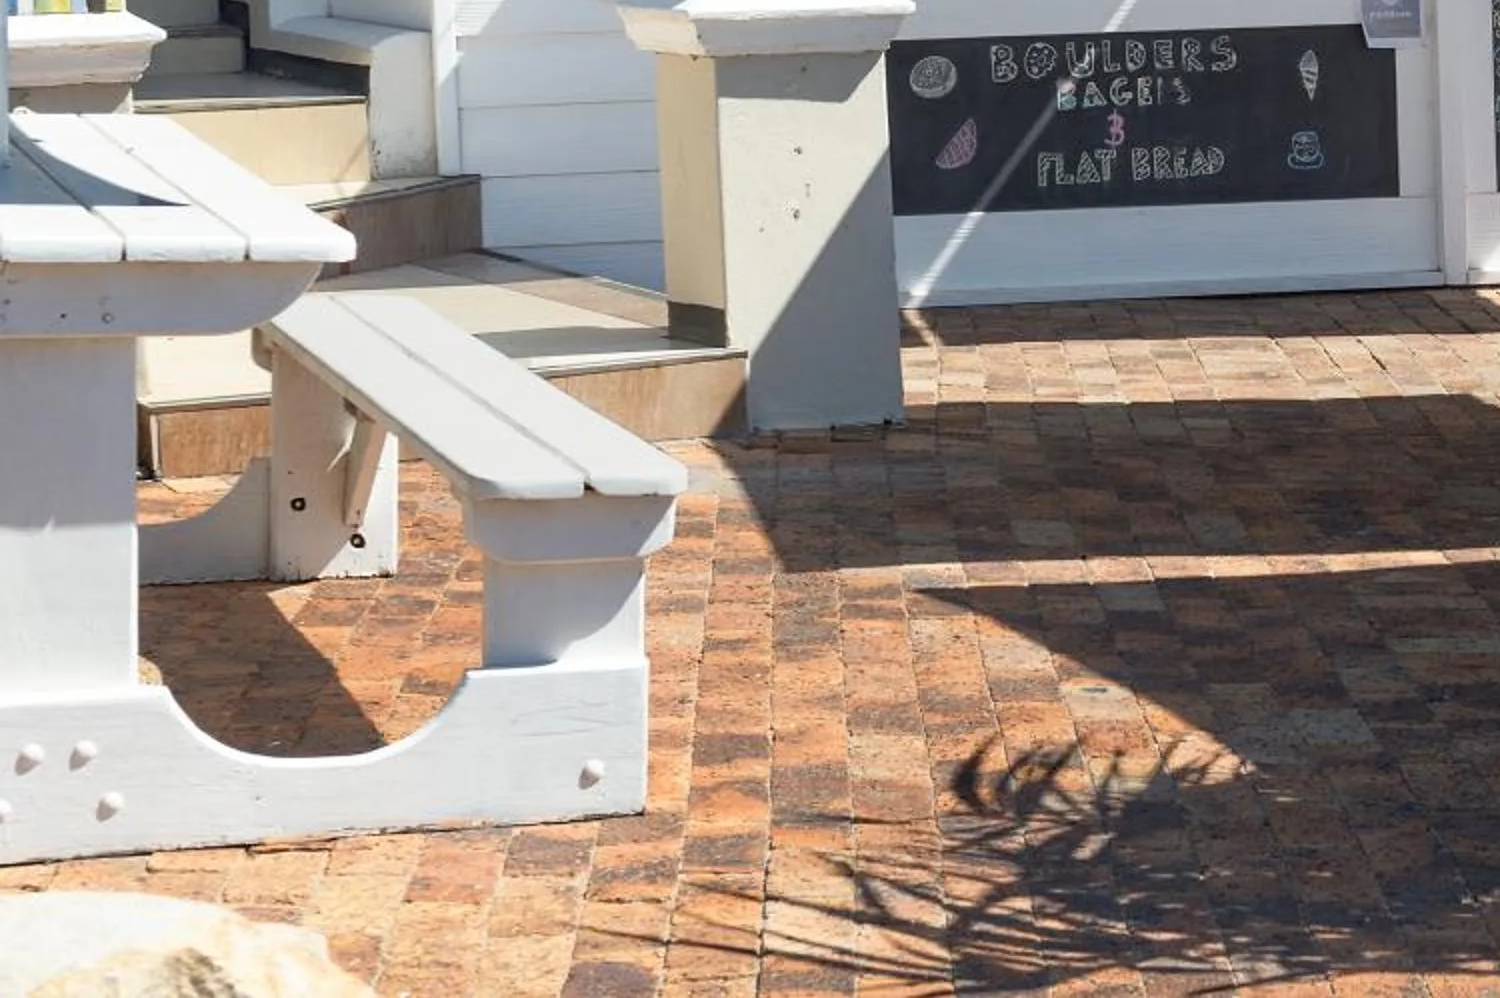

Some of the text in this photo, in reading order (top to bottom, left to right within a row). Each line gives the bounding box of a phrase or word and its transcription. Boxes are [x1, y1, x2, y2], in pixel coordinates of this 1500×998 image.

[989, 35, 1238, 83] BOULDERS
[1037, 145, 1225, 188] FLAT BREAD
